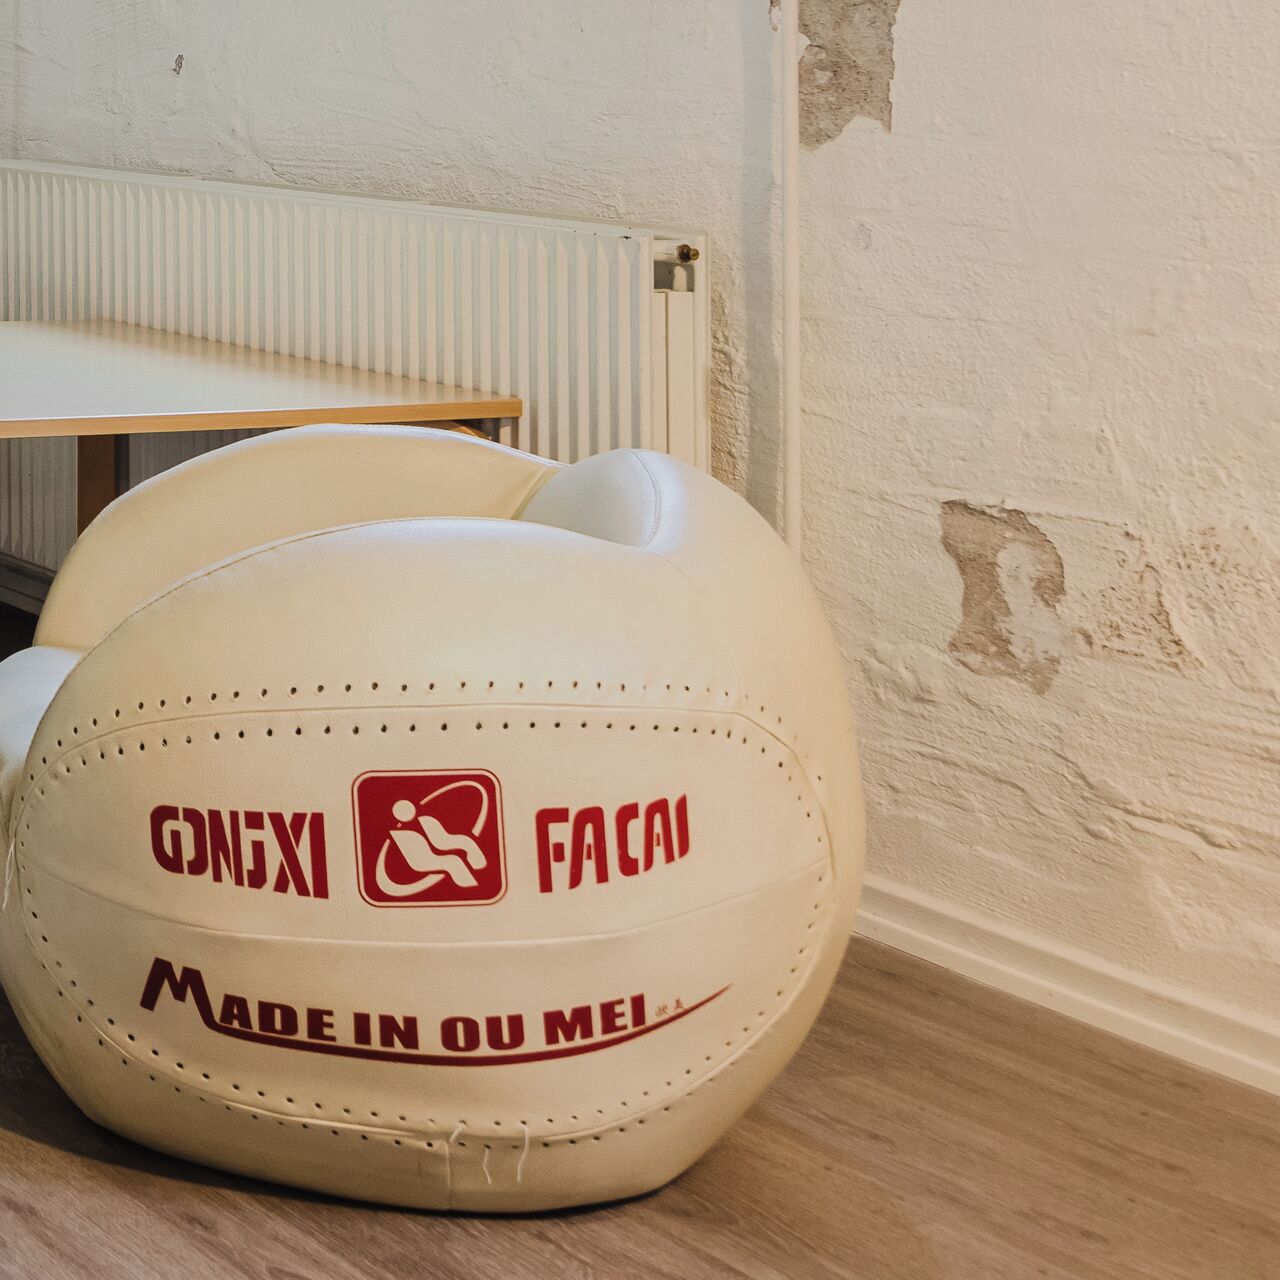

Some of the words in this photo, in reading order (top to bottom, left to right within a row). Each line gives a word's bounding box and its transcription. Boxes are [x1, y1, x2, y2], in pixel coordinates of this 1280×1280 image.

[535, 794, 690, 893] FACAI
[140, 957, 337, 1043] MADE
[354, 1012, 419, 1050] IN
[440, 1013, 525, 1052] OU
[543, 993, 646, 1046] MEI
